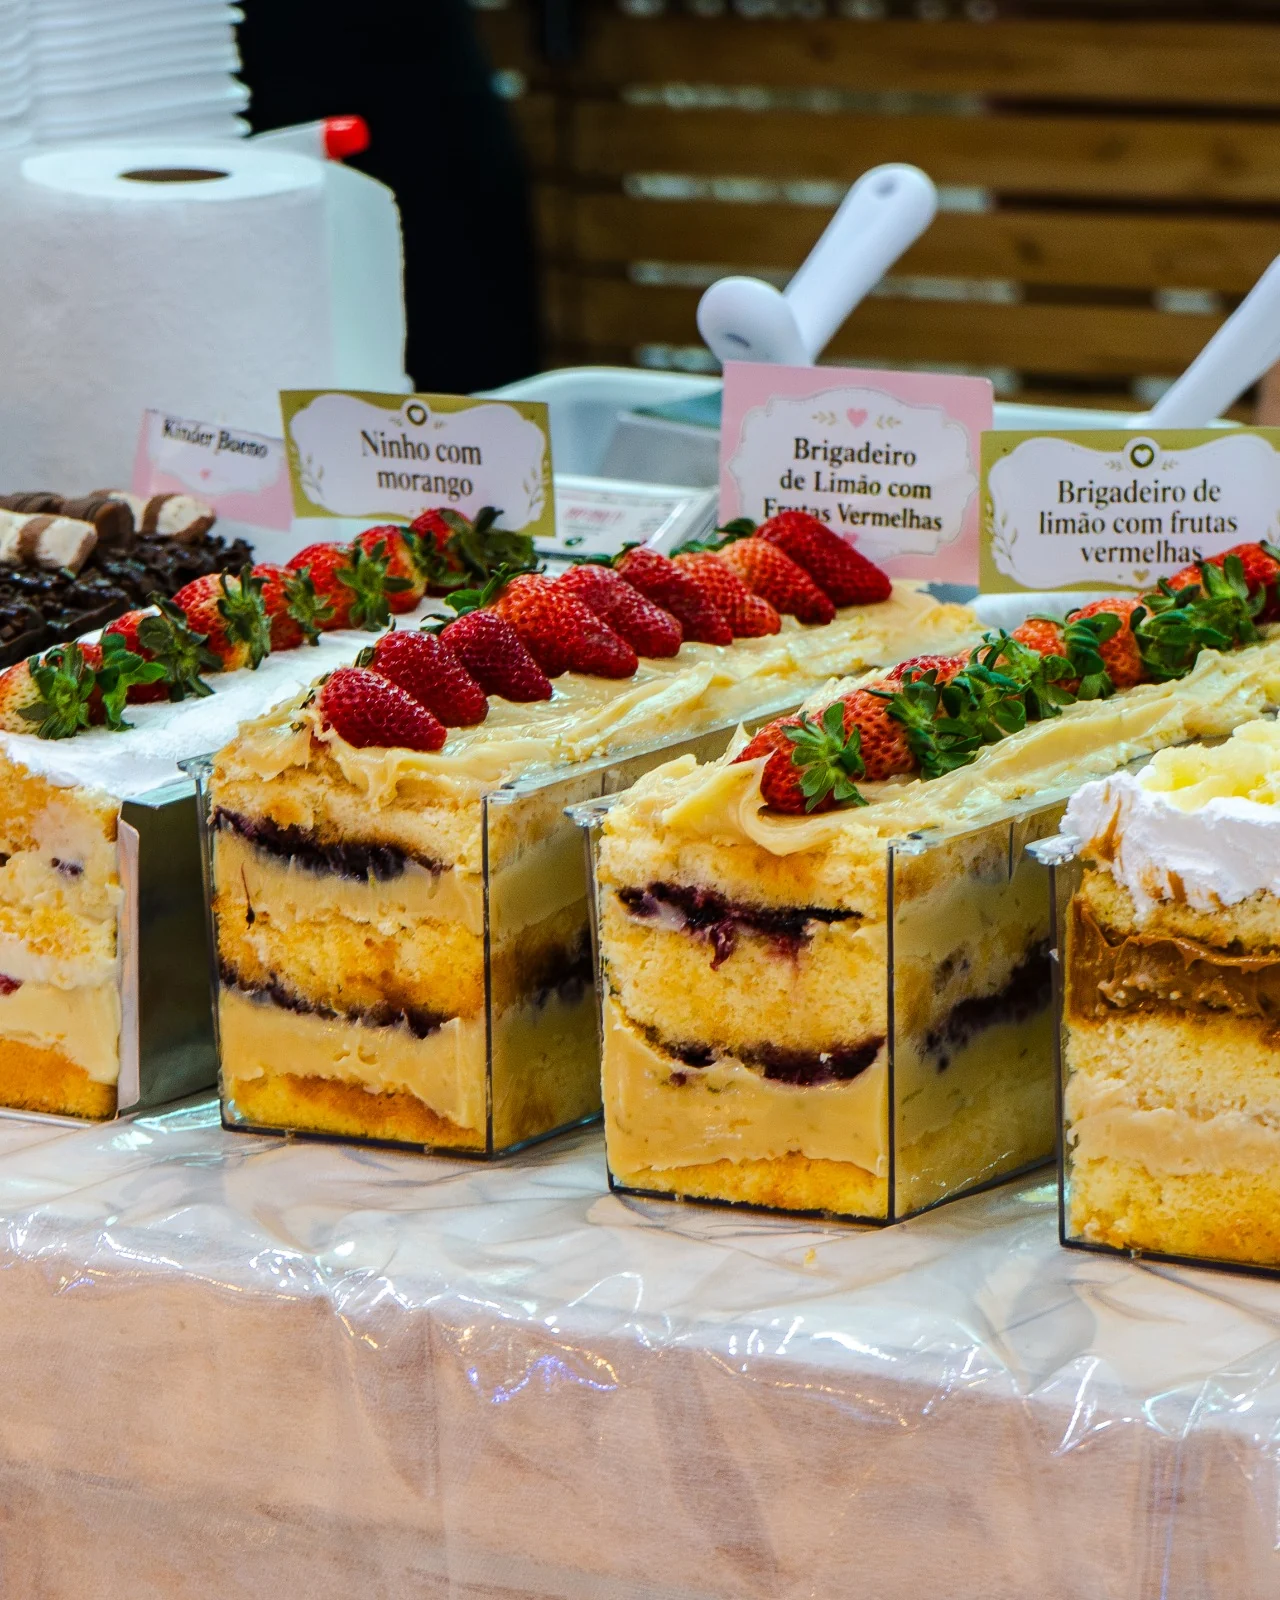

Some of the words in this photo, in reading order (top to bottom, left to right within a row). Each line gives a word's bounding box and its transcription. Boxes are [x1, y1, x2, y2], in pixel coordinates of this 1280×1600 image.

[361, 430, 431, 461] Ninho
[435, 443, 482, 465] com
[793, 437, 917, 468] Brigadeiro
[376, 470, 474, 502] morango
[780, 469, 806, 491] de
[814, 471, 881, 496] Limão
[887, 481, 932, 500] com
[1057, 479, 1186, 510] Brigadeiro
[1192, 478, 1222, 503] de
[838, 502, 942, 531] Vermelhas
[1039, 511, 1106, 535] limão
[1112, 516, 1163, 535] com
[1170, 510, 1238, 534] frutas
[1080, 540, 1203, 564] vermelhas
